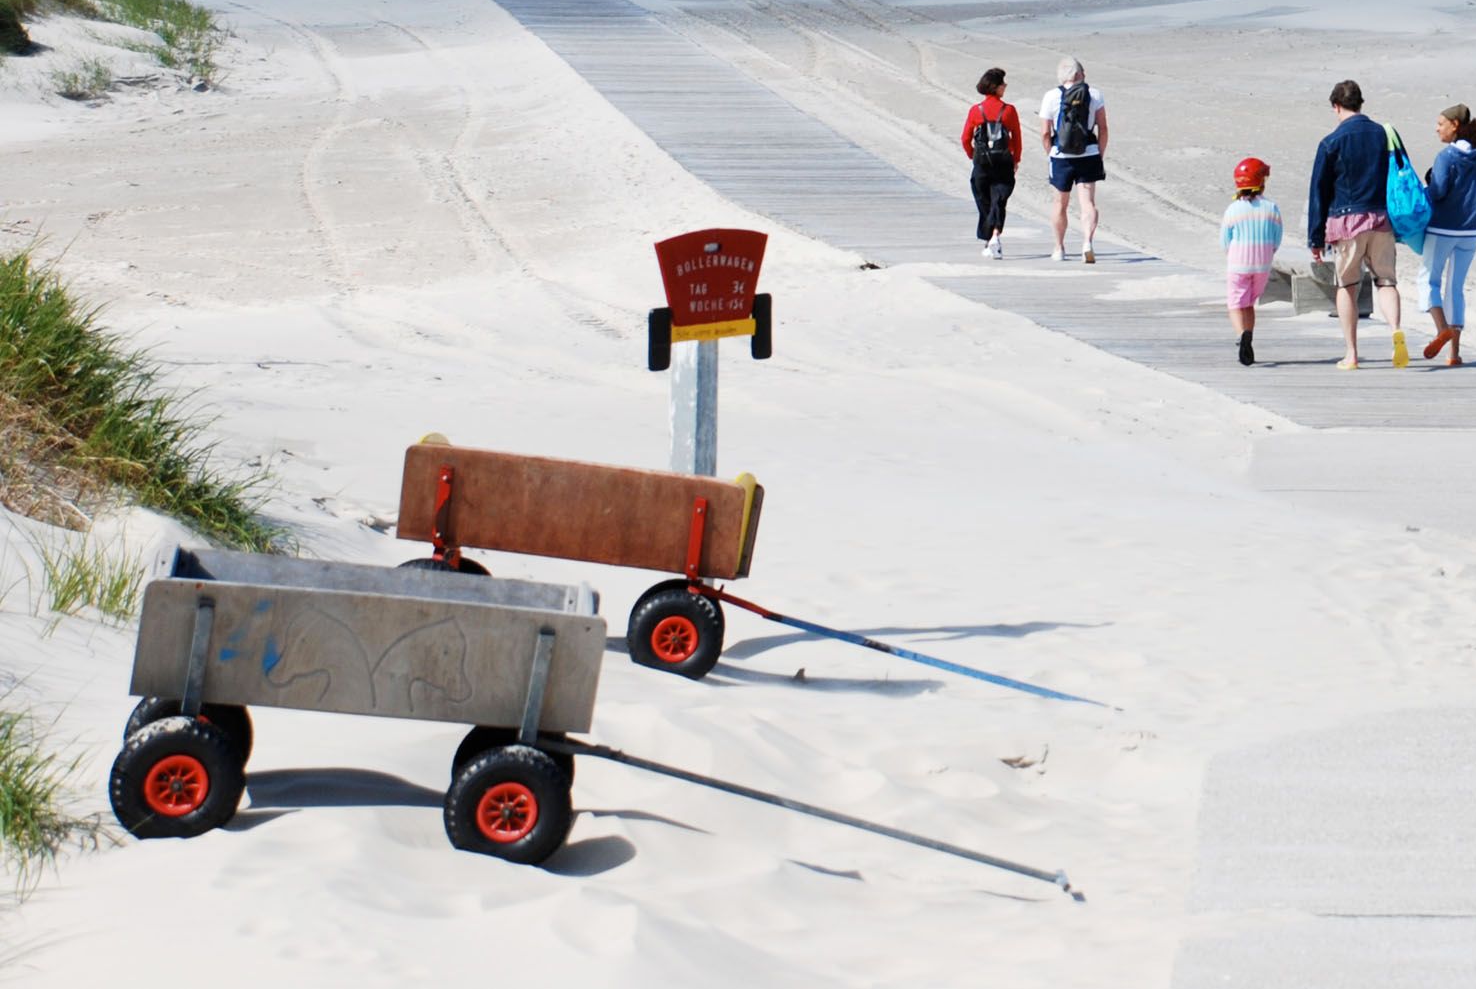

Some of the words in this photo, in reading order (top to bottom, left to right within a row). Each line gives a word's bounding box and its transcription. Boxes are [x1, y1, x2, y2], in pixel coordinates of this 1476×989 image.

[676, 255, 755, 277] BOLLERWAGEN
[689, 283, 708, 295] TAG
[689, 298, 724, 313] WOCHE
